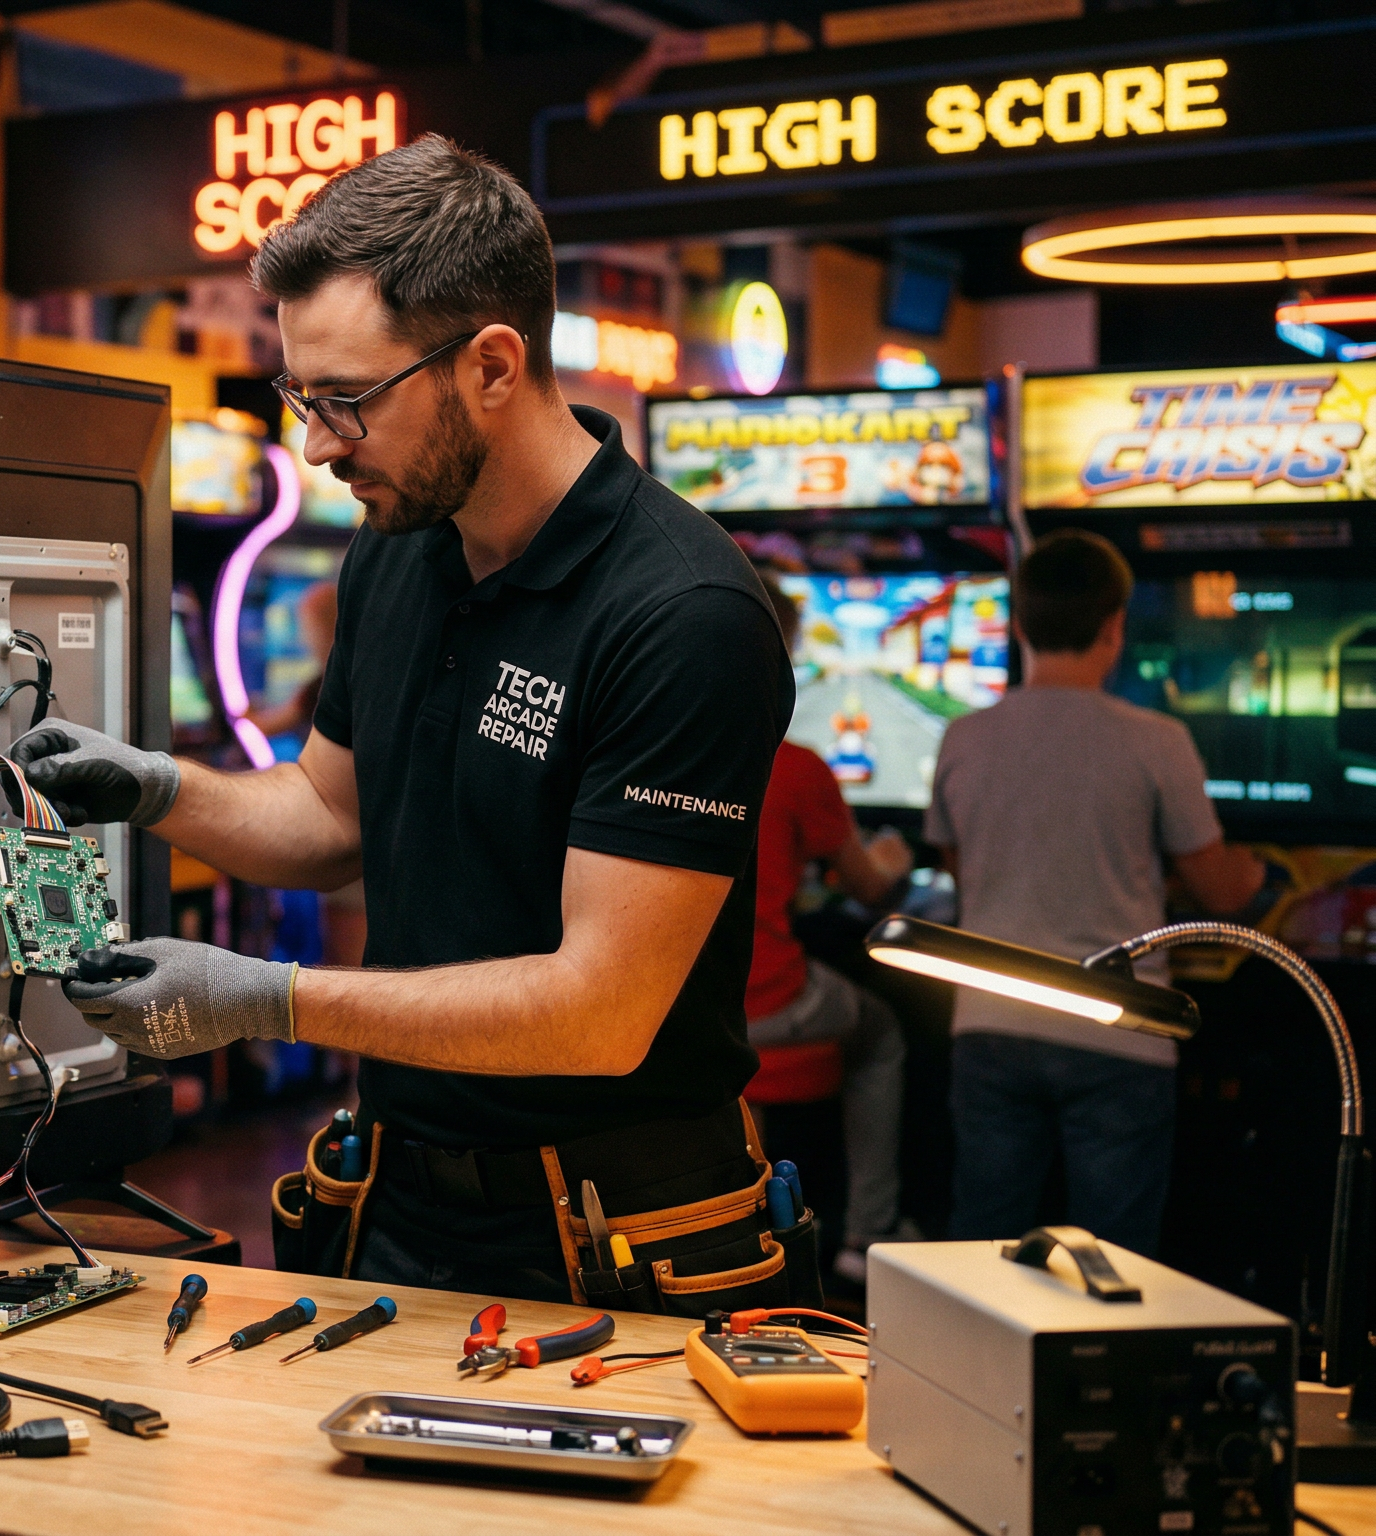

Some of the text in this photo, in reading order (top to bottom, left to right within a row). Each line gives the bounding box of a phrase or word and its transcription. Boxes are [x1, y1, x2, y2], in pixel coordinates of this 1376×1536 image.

[215, 91, 395, 180] HIGH
[660, 58, 1228, 180] HIGH SCORE
[1130, 375, 1338, 428] TIME
[1080, 421, 1367, 496] CRISIS
[496, 660, 566, 715] TECH
[477, 714, 548, 761] REPAIR
[484, 693, 558, 738] ARCADE
[624, 784, 747, 821] MAINTENANCE
